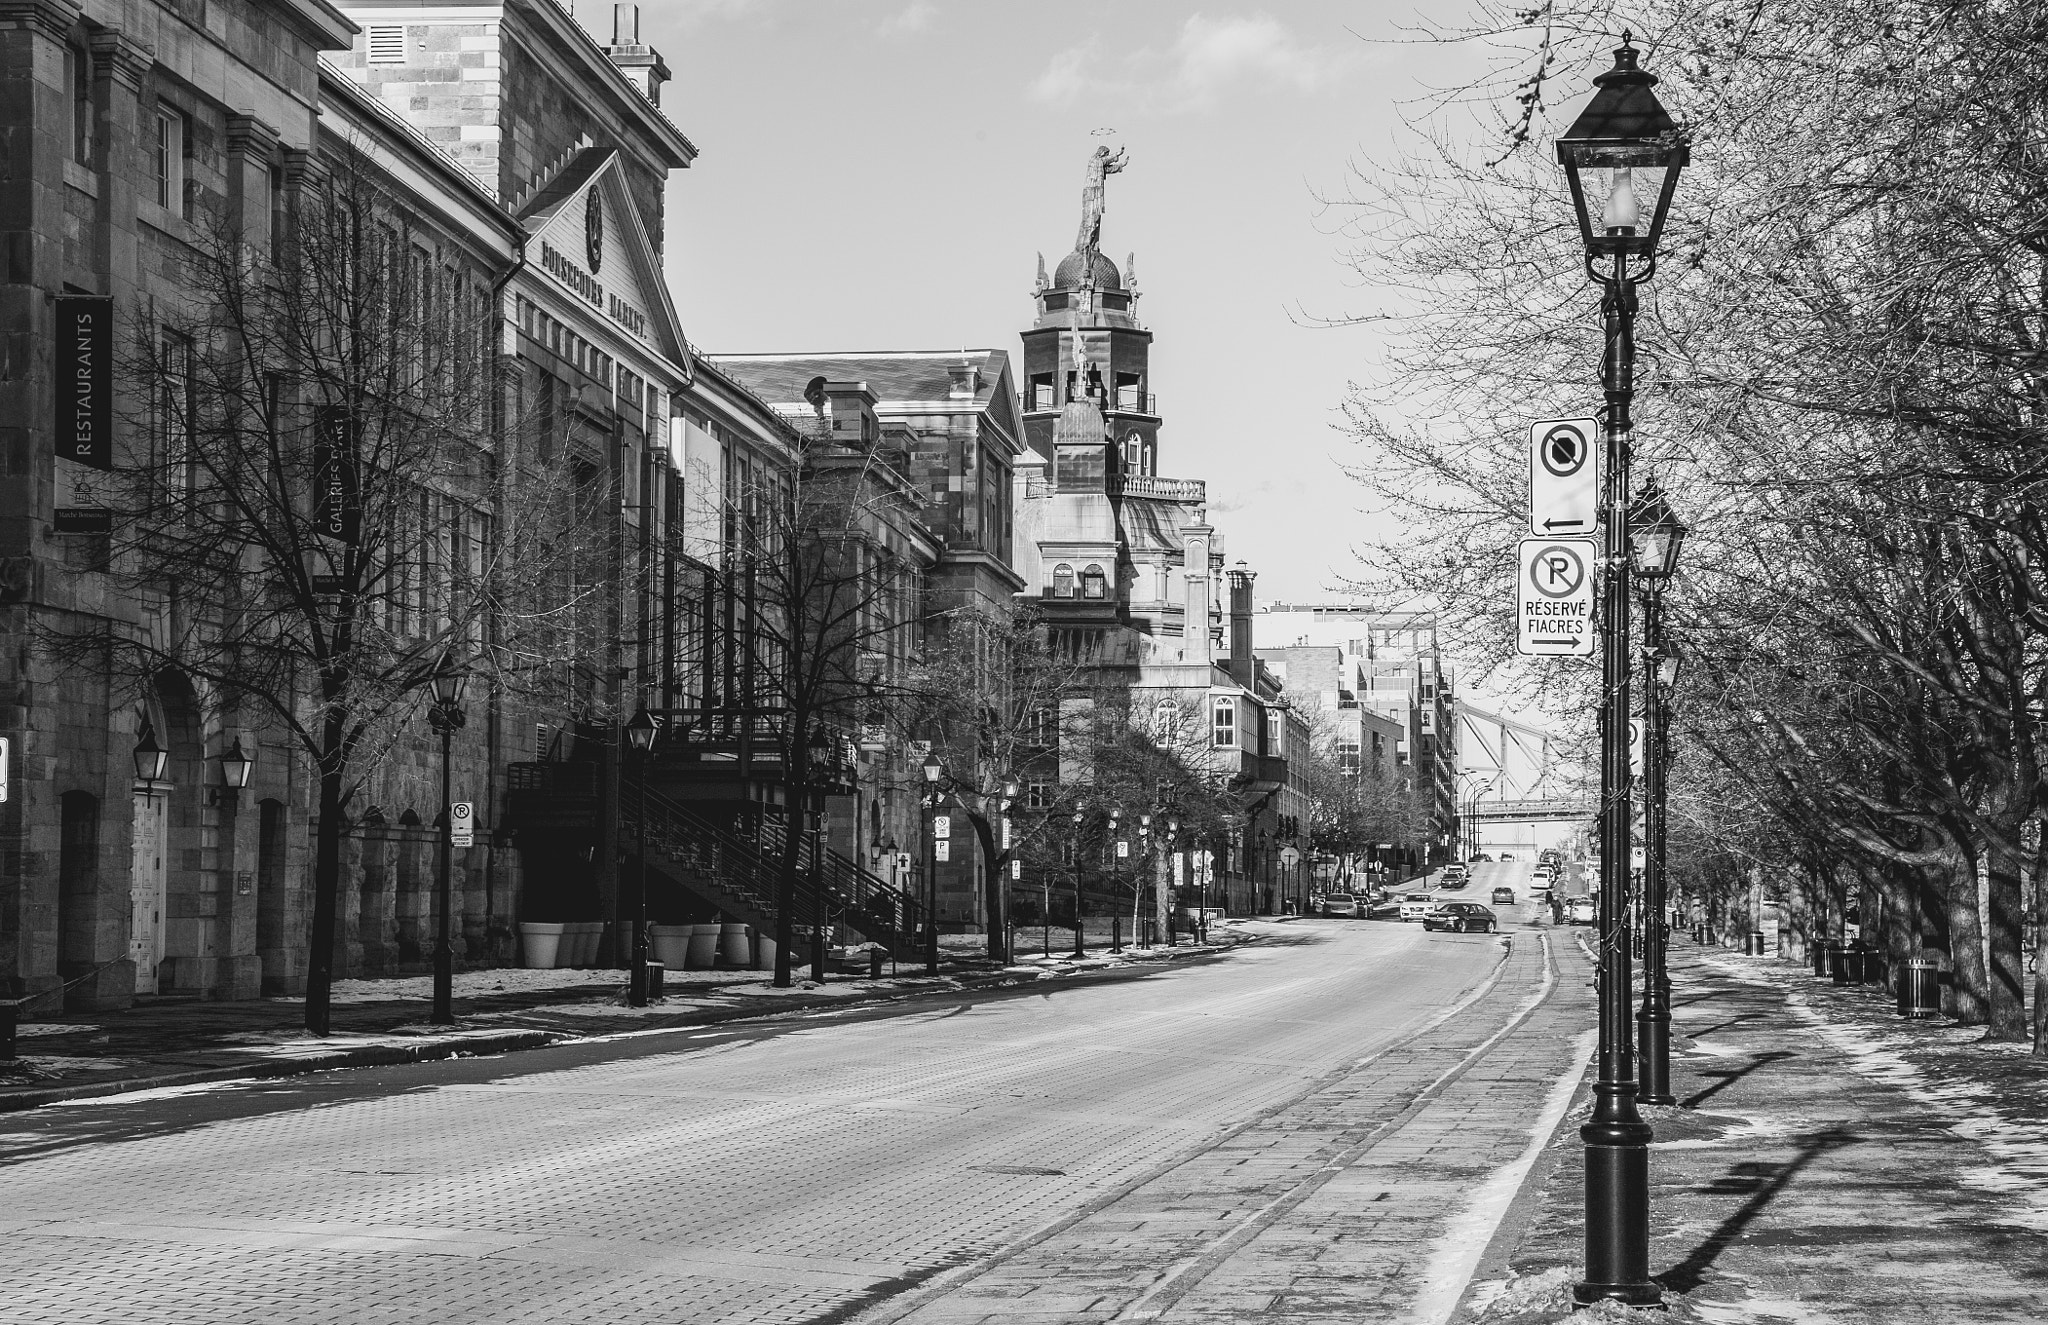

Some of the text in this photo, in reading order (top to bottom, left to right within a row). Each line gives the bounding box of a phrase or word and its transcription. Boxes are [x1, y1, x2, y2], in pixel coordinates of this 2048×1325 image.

[542, 240, 603, 308] BONSECOURS
[76, 313, 92, 455] RESTAURANTS
[1549, 557, 1569, 585] P
[1525, 597, 1587, 617] RÉSERVÉ
[1528, 619, 1583, 634] FIACRES
